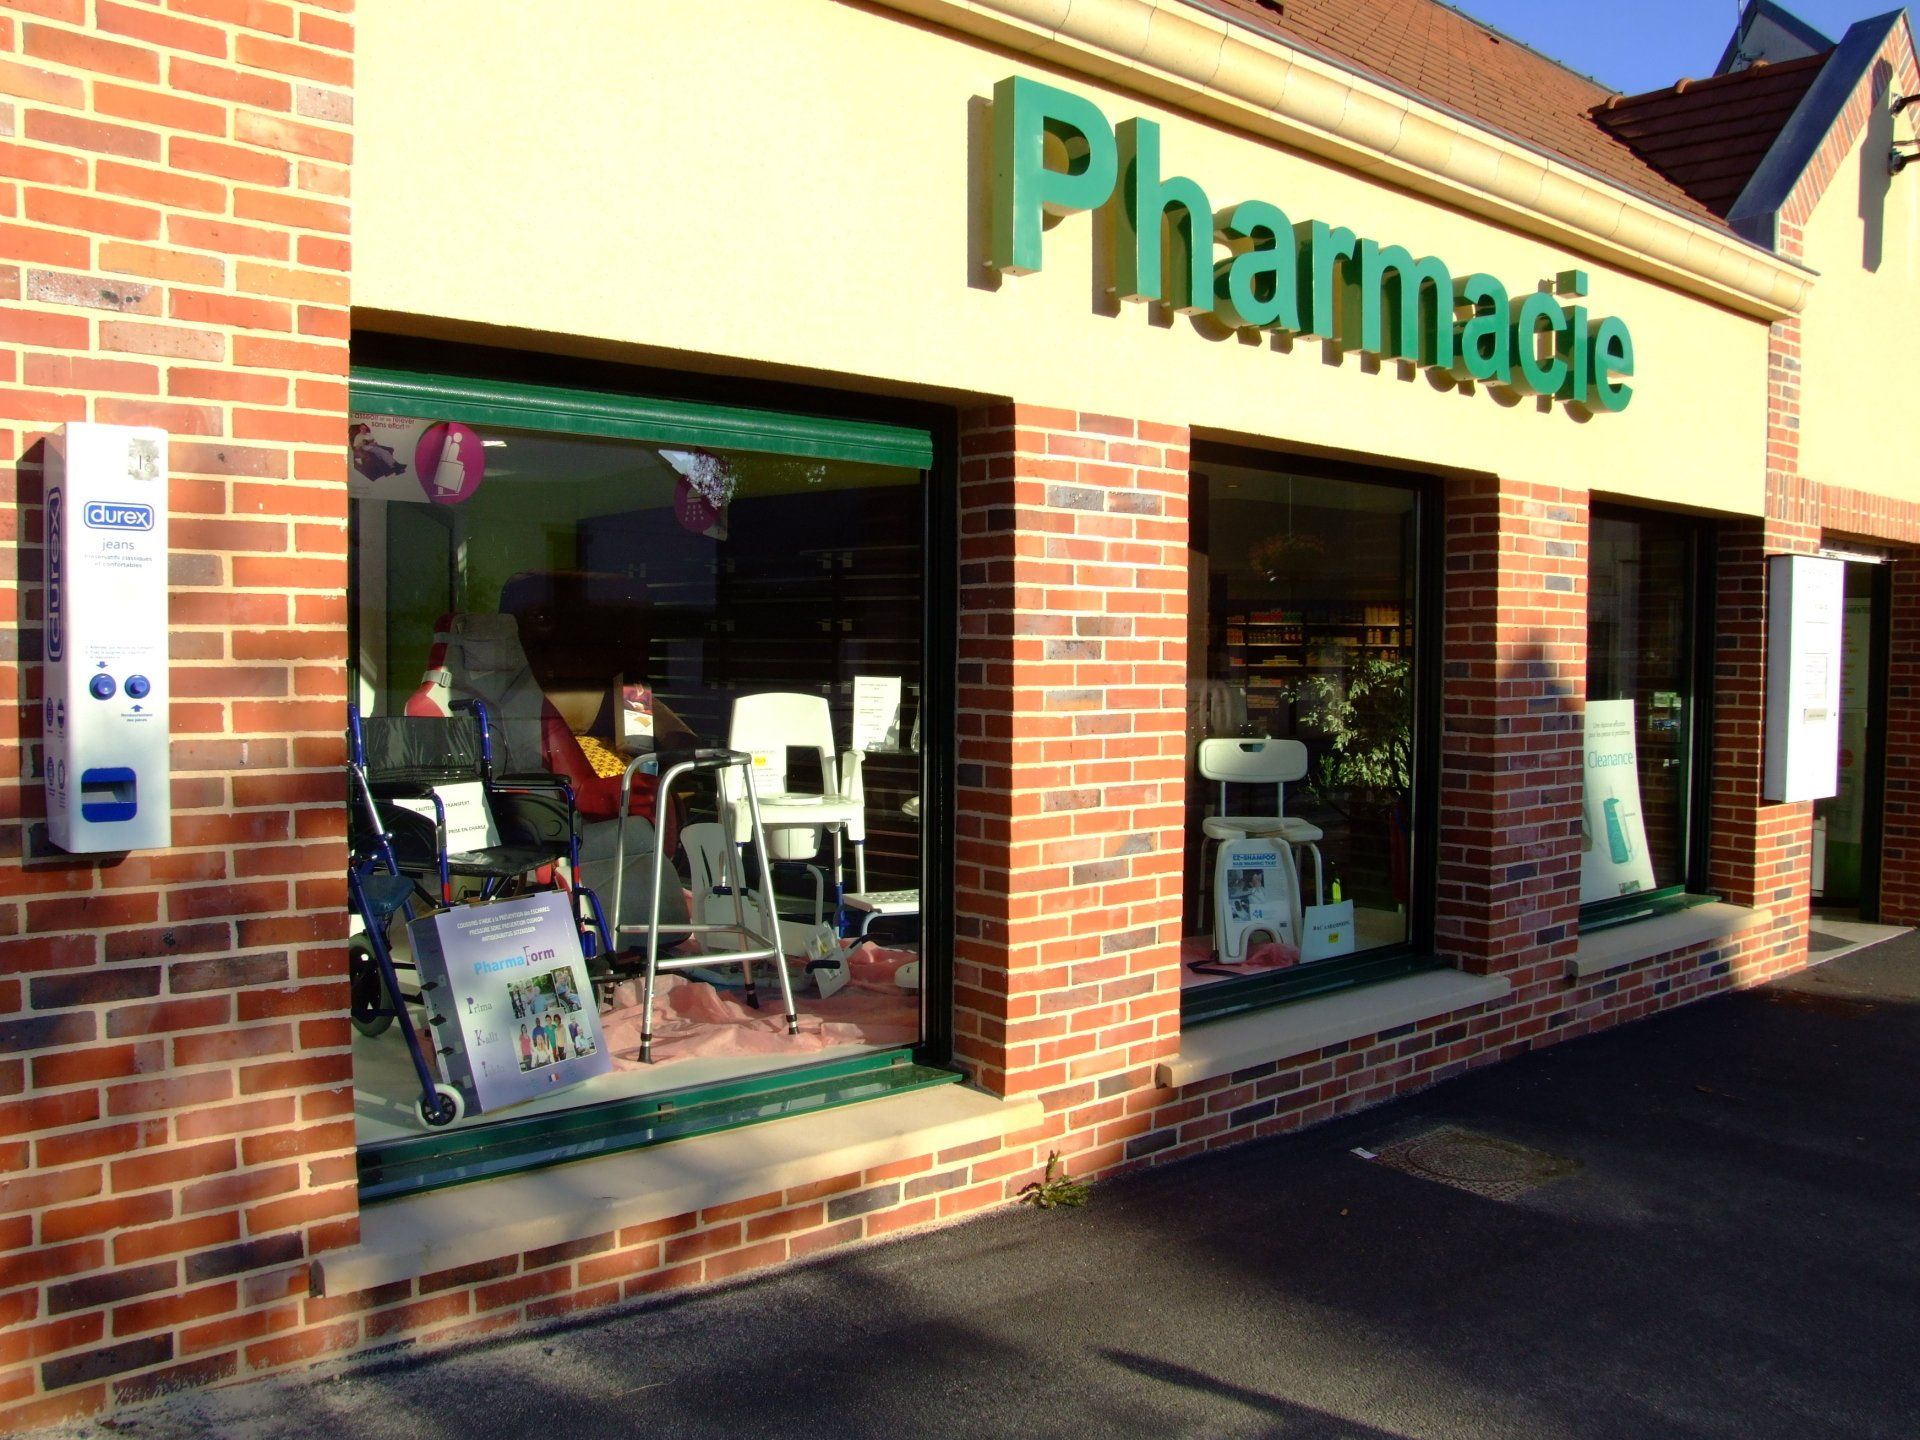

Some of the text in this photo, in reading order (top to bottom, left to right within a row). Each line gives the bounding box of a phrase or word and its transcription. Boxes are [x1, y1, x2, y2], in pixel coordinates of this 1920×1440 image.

[993, 75, 1634, 414] Pharmacie
[90, 504, 150, 529] durex
[102, 538, 135, 552] jeans
[49, 495, 61, 645] durex
[1588, 751, 1634, 769] Cleanance
[466, 996, 493, 1015] Prima
